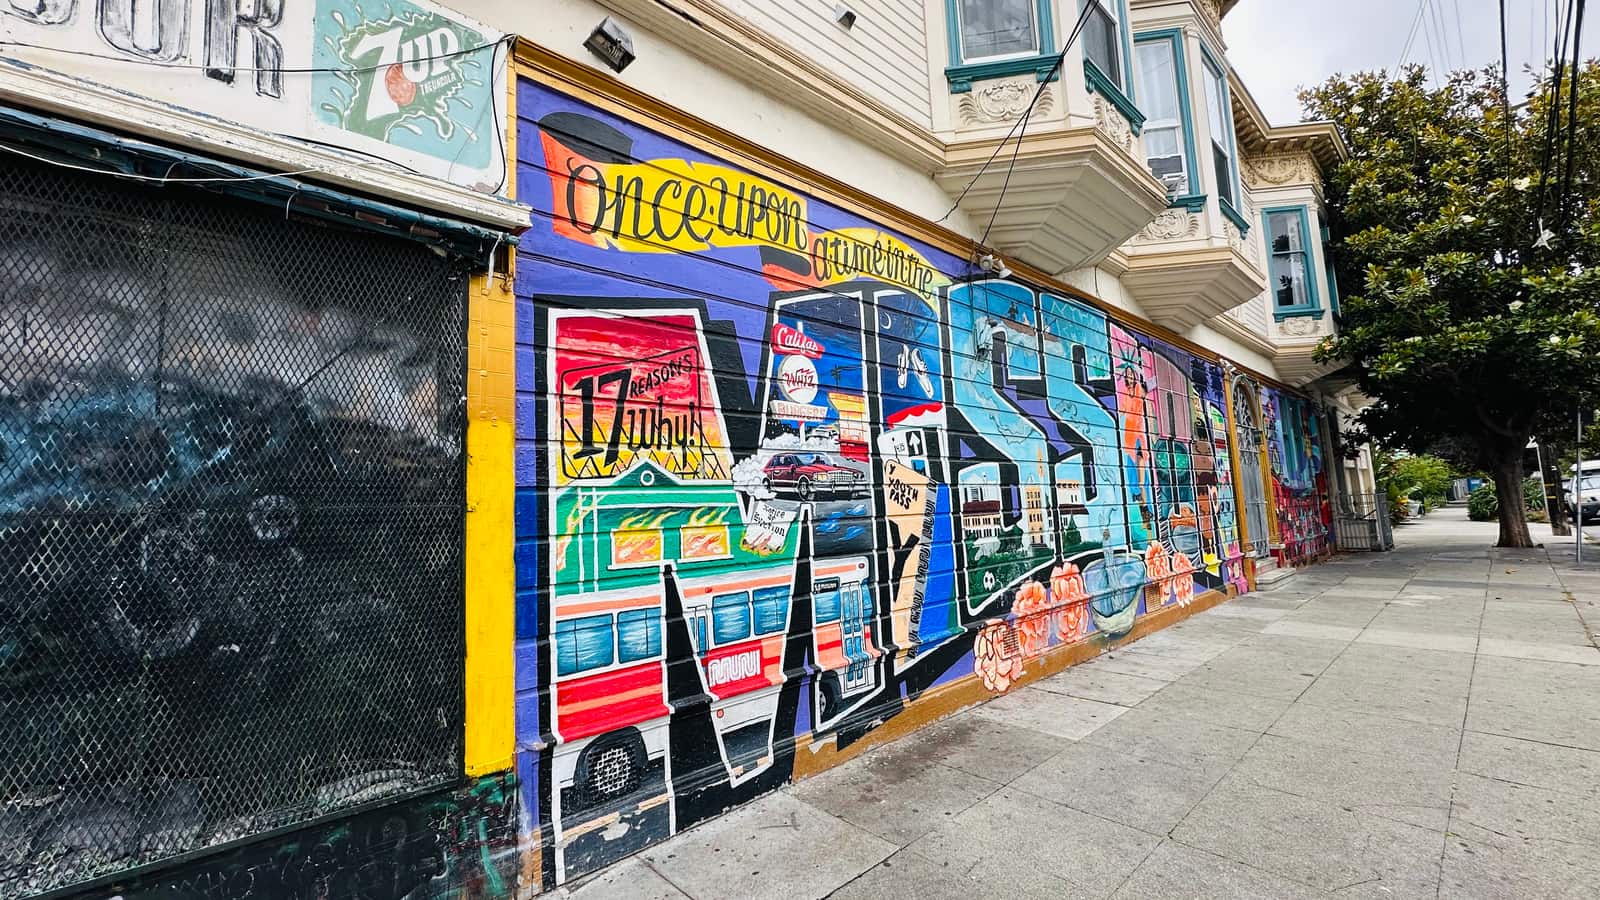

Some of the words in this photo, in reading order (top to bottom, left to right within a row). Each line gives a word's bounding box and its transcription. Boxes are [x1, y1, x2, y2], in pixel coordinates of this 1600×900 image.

[572, 368, 632, 468] 17
[630, 353, 693, 398] REASONS
[888, 477, 918, 502] YOUTH
[889, 488, 912, 510] PASS
